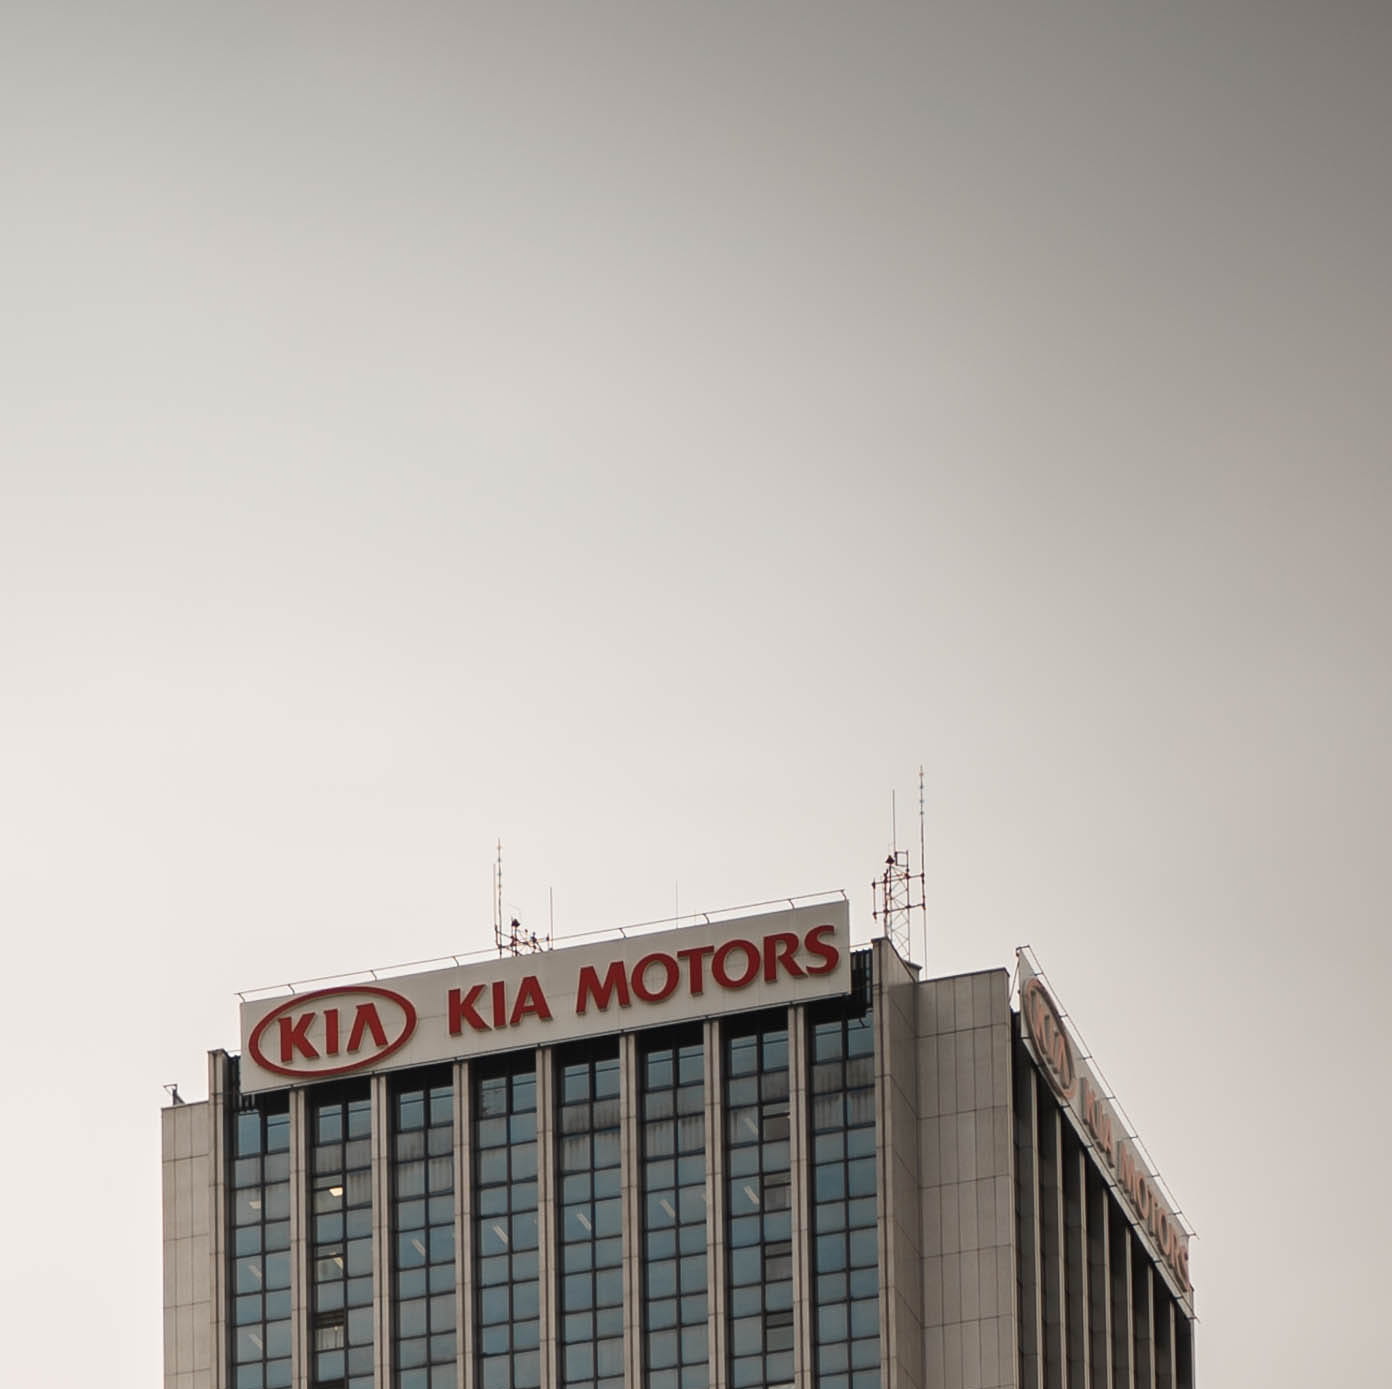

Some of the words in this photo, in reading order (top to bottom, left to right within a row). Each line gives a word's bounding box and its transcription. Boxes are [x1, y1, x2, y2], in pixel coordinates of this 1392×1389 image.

[278, 1002, 387, 1063] KIA
[449, 976, 551, 1036] KIA
[576, 925, 840, 1014] MOTORS
[1081, 1078, 1115, 1167] KIA
[1118, 1143, 1191, 1293] MOTORS
